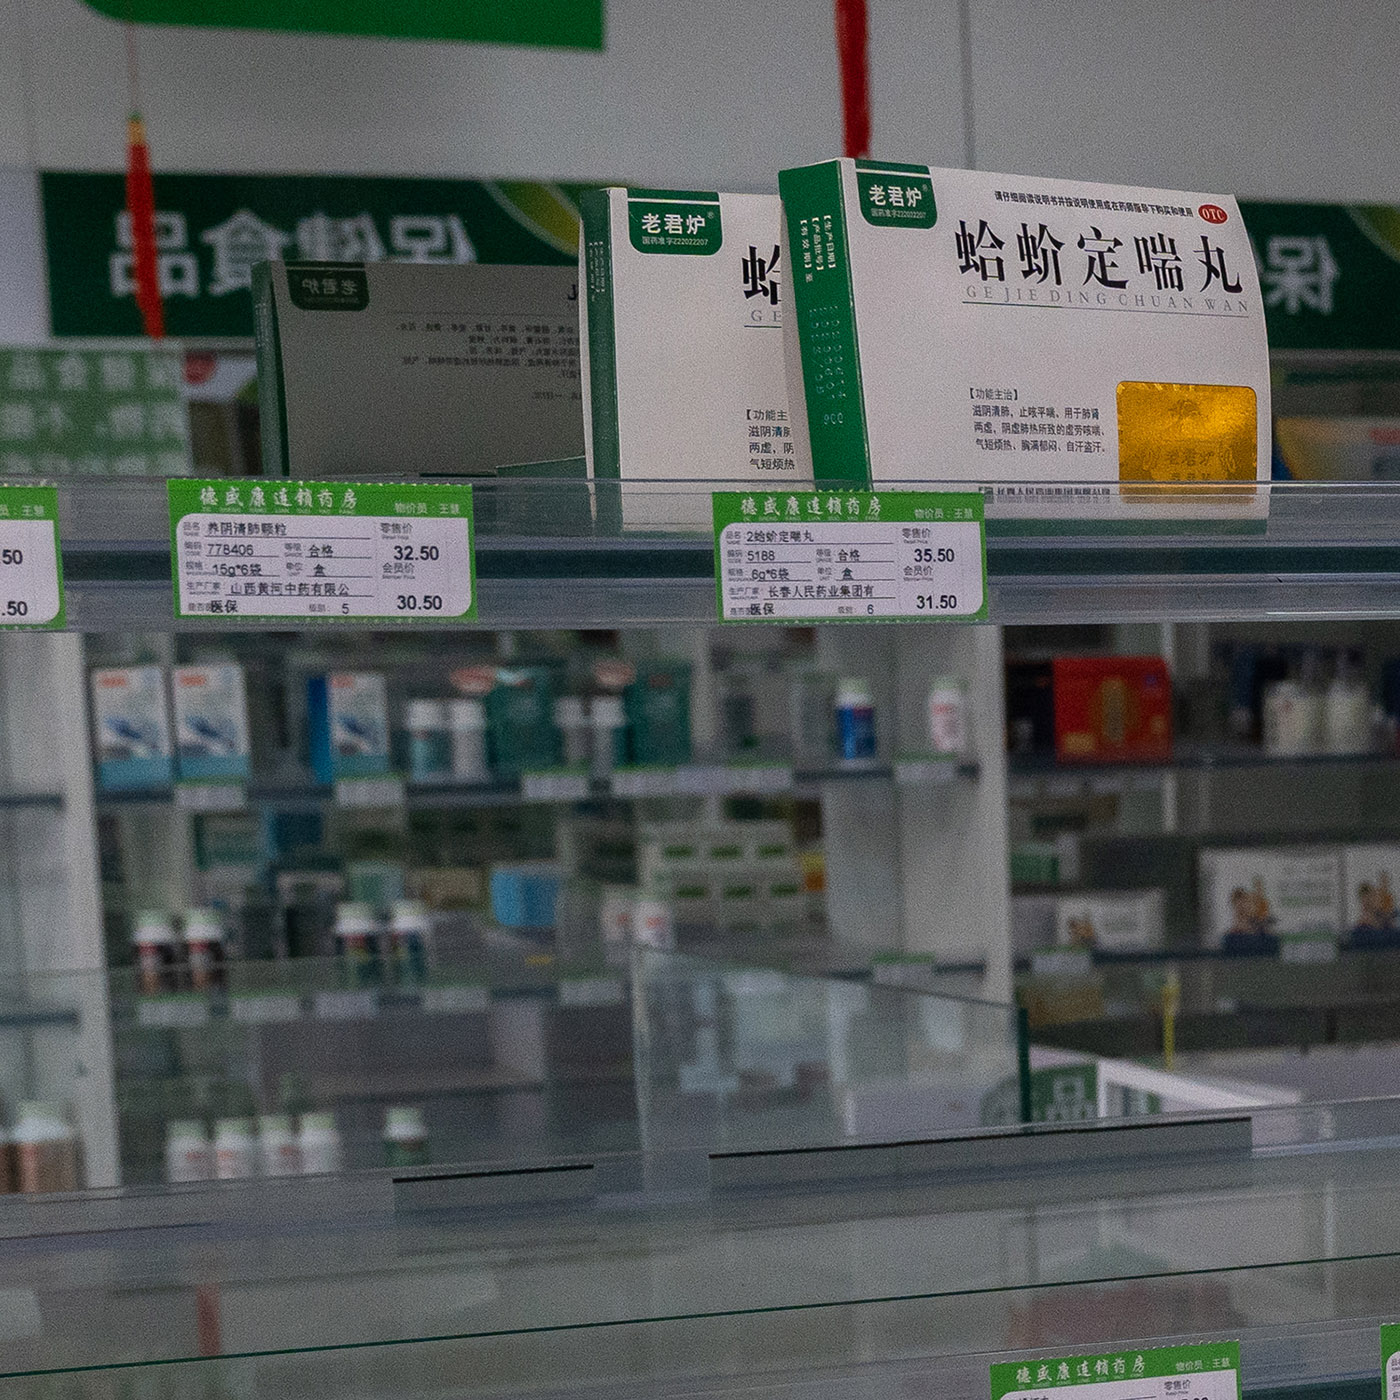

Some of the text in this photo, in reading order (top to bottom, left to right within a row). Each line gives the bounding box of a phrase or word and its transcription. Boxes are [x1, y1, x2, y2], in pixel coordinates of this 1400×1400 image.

[869, 185, 922, 207] 老君炉
[1201, 208, 1226, 221] OTC
[642, 213, 706, 234] 老君炉
[955, 219, 1243, 294] 蛤蚧定喘丸
[966, 285, 1249, 313] GE JIE DING CHUAN WAN
[751, 310, 781, 322] GE
[968, 388, 1020, 401] 【功能主治】
[750, 458, 795, 470] 气短烦热
[207, 523, 287, 535] 养阴清肺颗粒
[207, 544, 253, 556] 778406
[393, 545, 439, 561] 32.50
[747, 551, 775, 562] 5188
[914, 548, 955, 562] 35.50
[768, 585, 874, 598] 长春人民药业集团有
[397, 595, 443, 611] 30.50
[916, 595, 957, 609] 31.50
